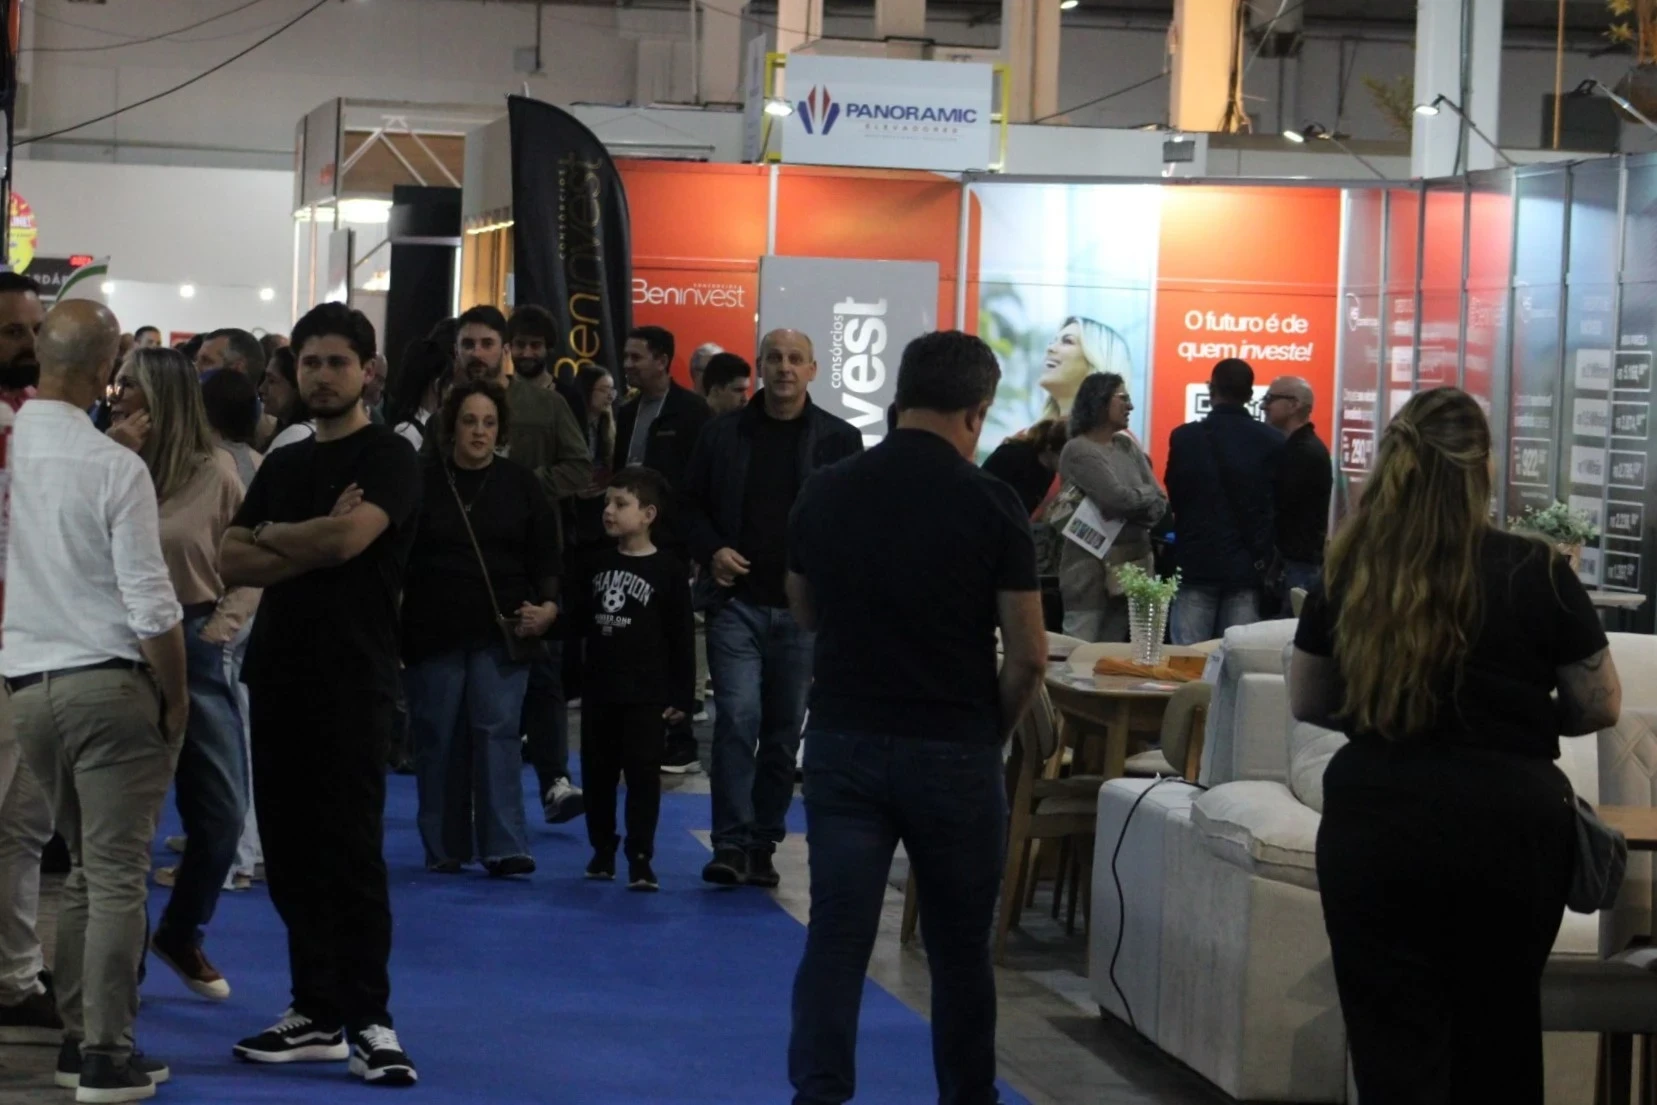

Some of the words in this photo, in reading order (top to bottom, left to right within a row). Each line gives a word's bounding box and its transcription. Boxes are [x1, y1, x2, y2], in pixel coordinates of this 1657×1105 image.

[846, 102, 977, 124] PANORAMIC
[632, 278, 745, 308] Beninvest
[1184, 309, 1203, 330] O
[1205, 311, 1263, 333] futuro
[1265, 314, 1279, 333] é
[1281, 314, 1309, 334] de
[829, 315, 844, 389] consórcios
[1177, 341, 1237, 362] quem
[1237, 340, 1314, 362] investe!
